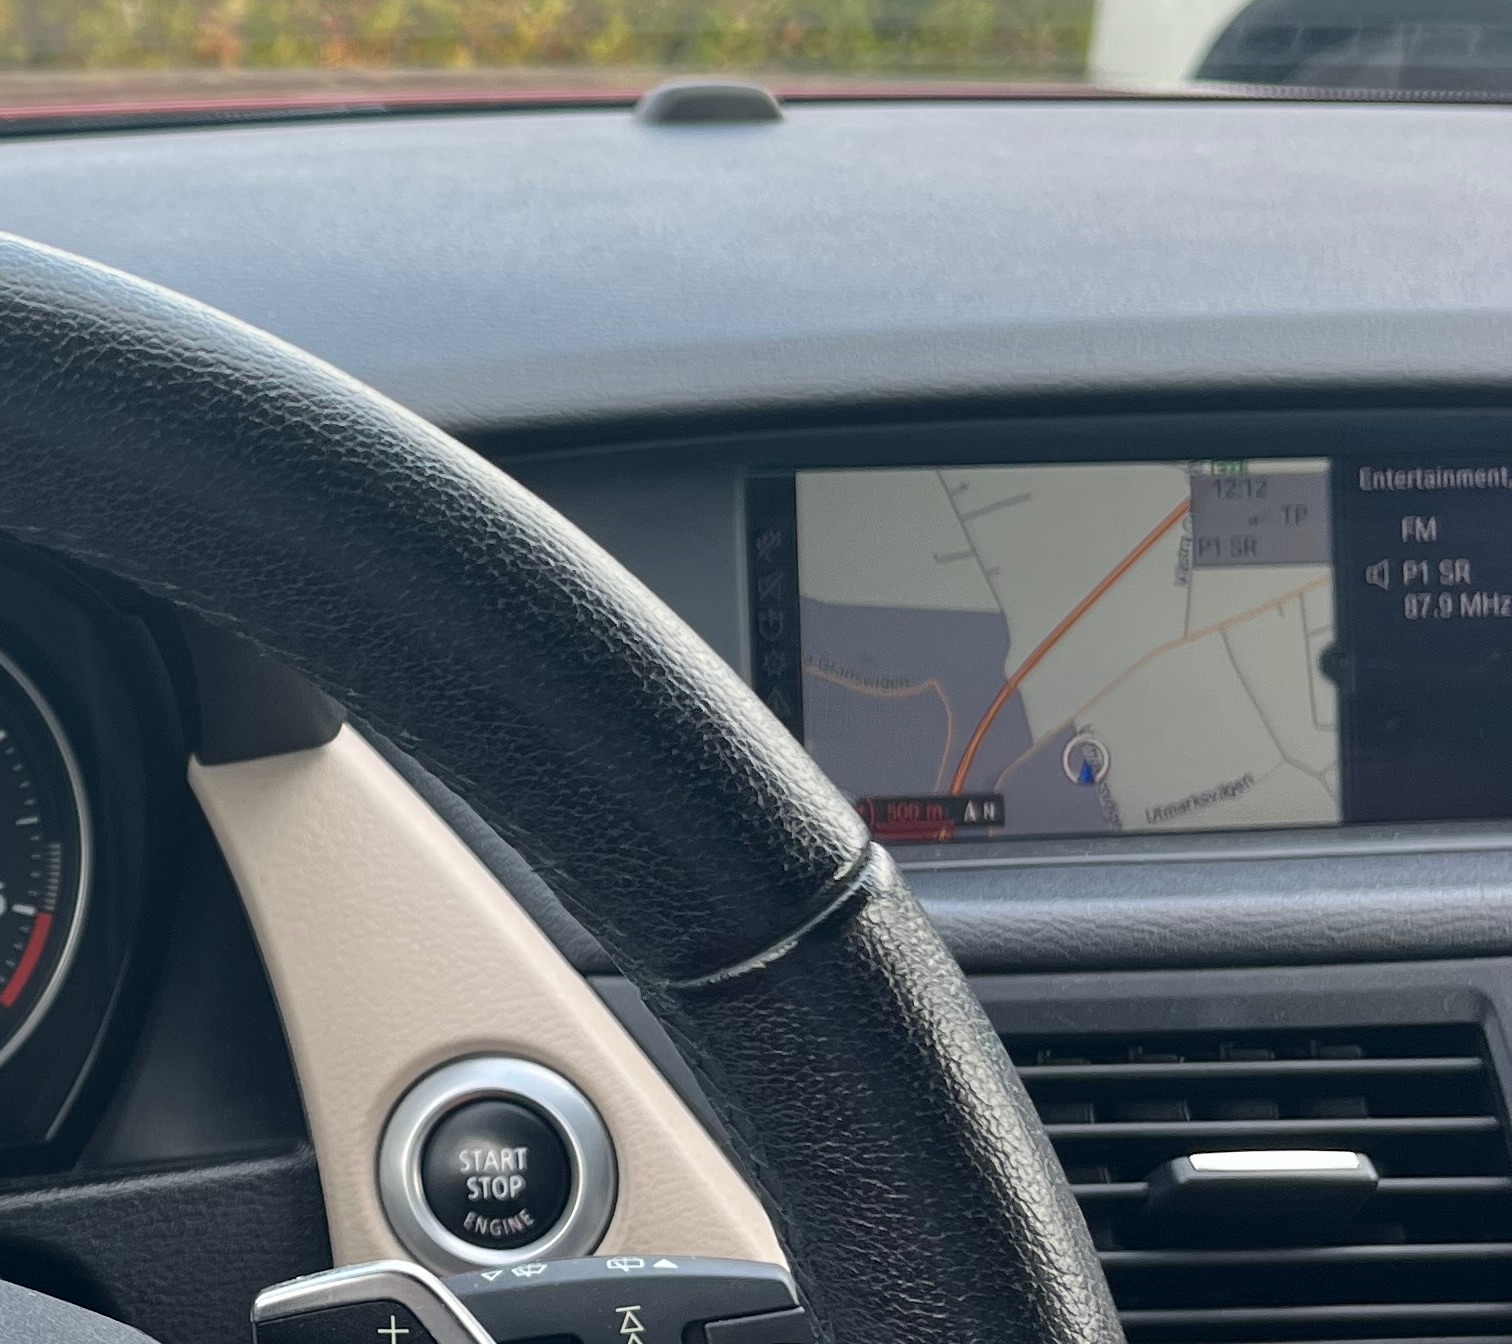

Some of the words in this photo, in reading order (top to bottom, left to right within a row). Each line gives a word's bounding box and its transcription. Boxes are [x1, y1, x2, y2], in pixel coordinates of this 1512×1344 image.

[1281, 503, 1308, 525] TP
[1401, 515, 1437, 542] FM
[1402, 559, 1429, 586] P1
[1439, 558, 1472, 585] SR
[1460, 590, 1512, 618] MHz
[984, 801, 995, 821] N
[459, 1147, 528, 1174] START
[466, 1175, 527, 1200] STOP
[463, 1208, 535, 1236] ENGINE
